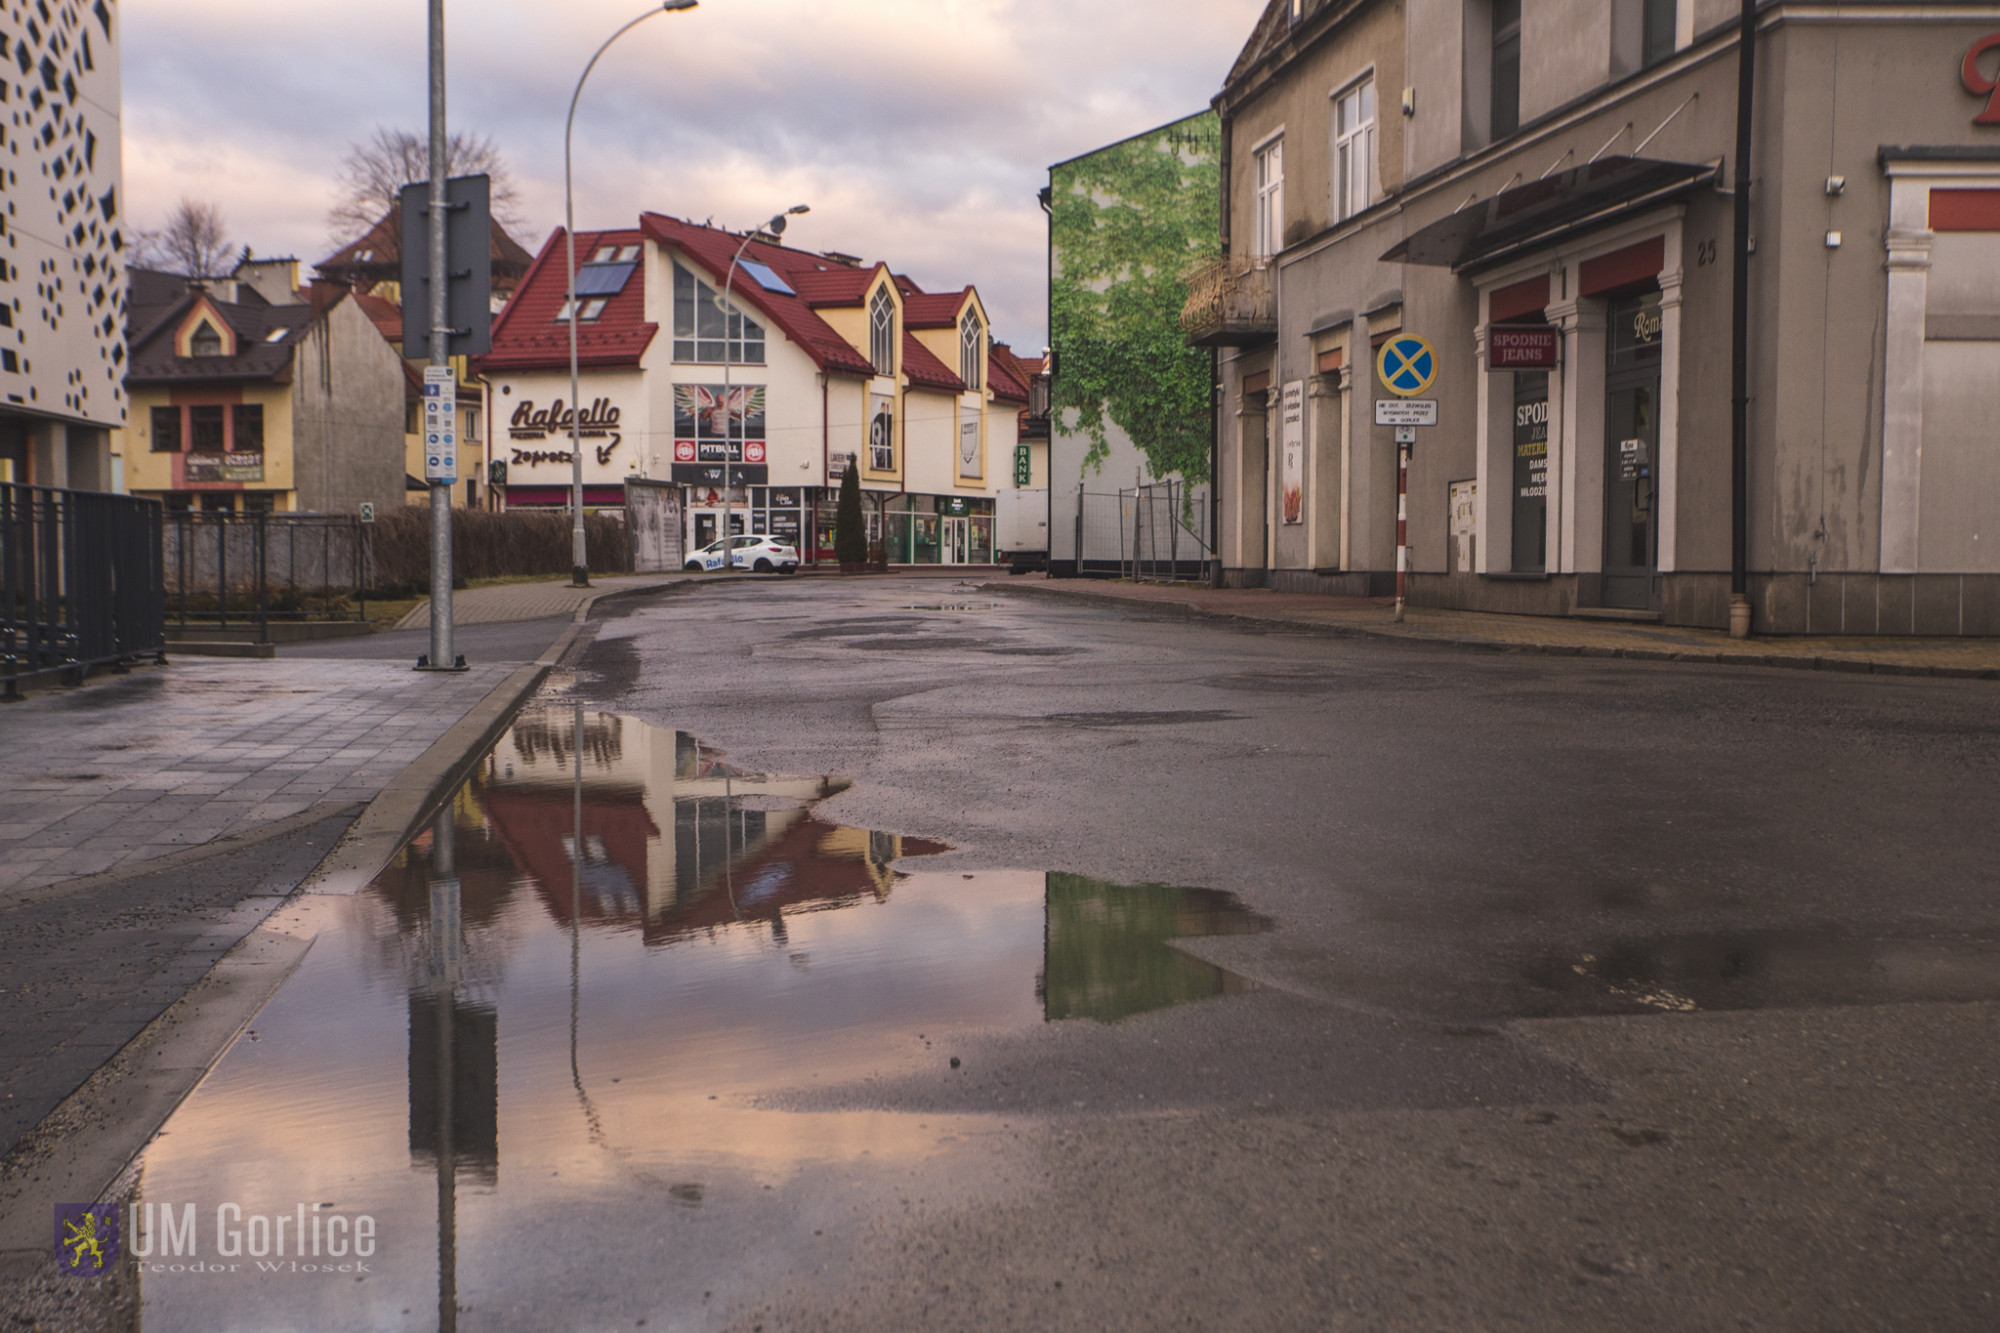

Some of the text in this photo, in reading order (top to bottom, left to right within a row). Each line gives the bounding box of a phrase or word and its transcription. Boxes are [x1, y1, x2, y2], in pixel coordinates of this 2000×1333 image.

[1697, 238, 1716, 268] 25
[1493, 334, 1552, 347] SPODNIE
[1502, 348, 1543, 363] JEANS
[510, 398, 620, 434] Rafaello
[1018, 447, 1027, 483] BANK
[706, 553, 744, 568] Rafallo
